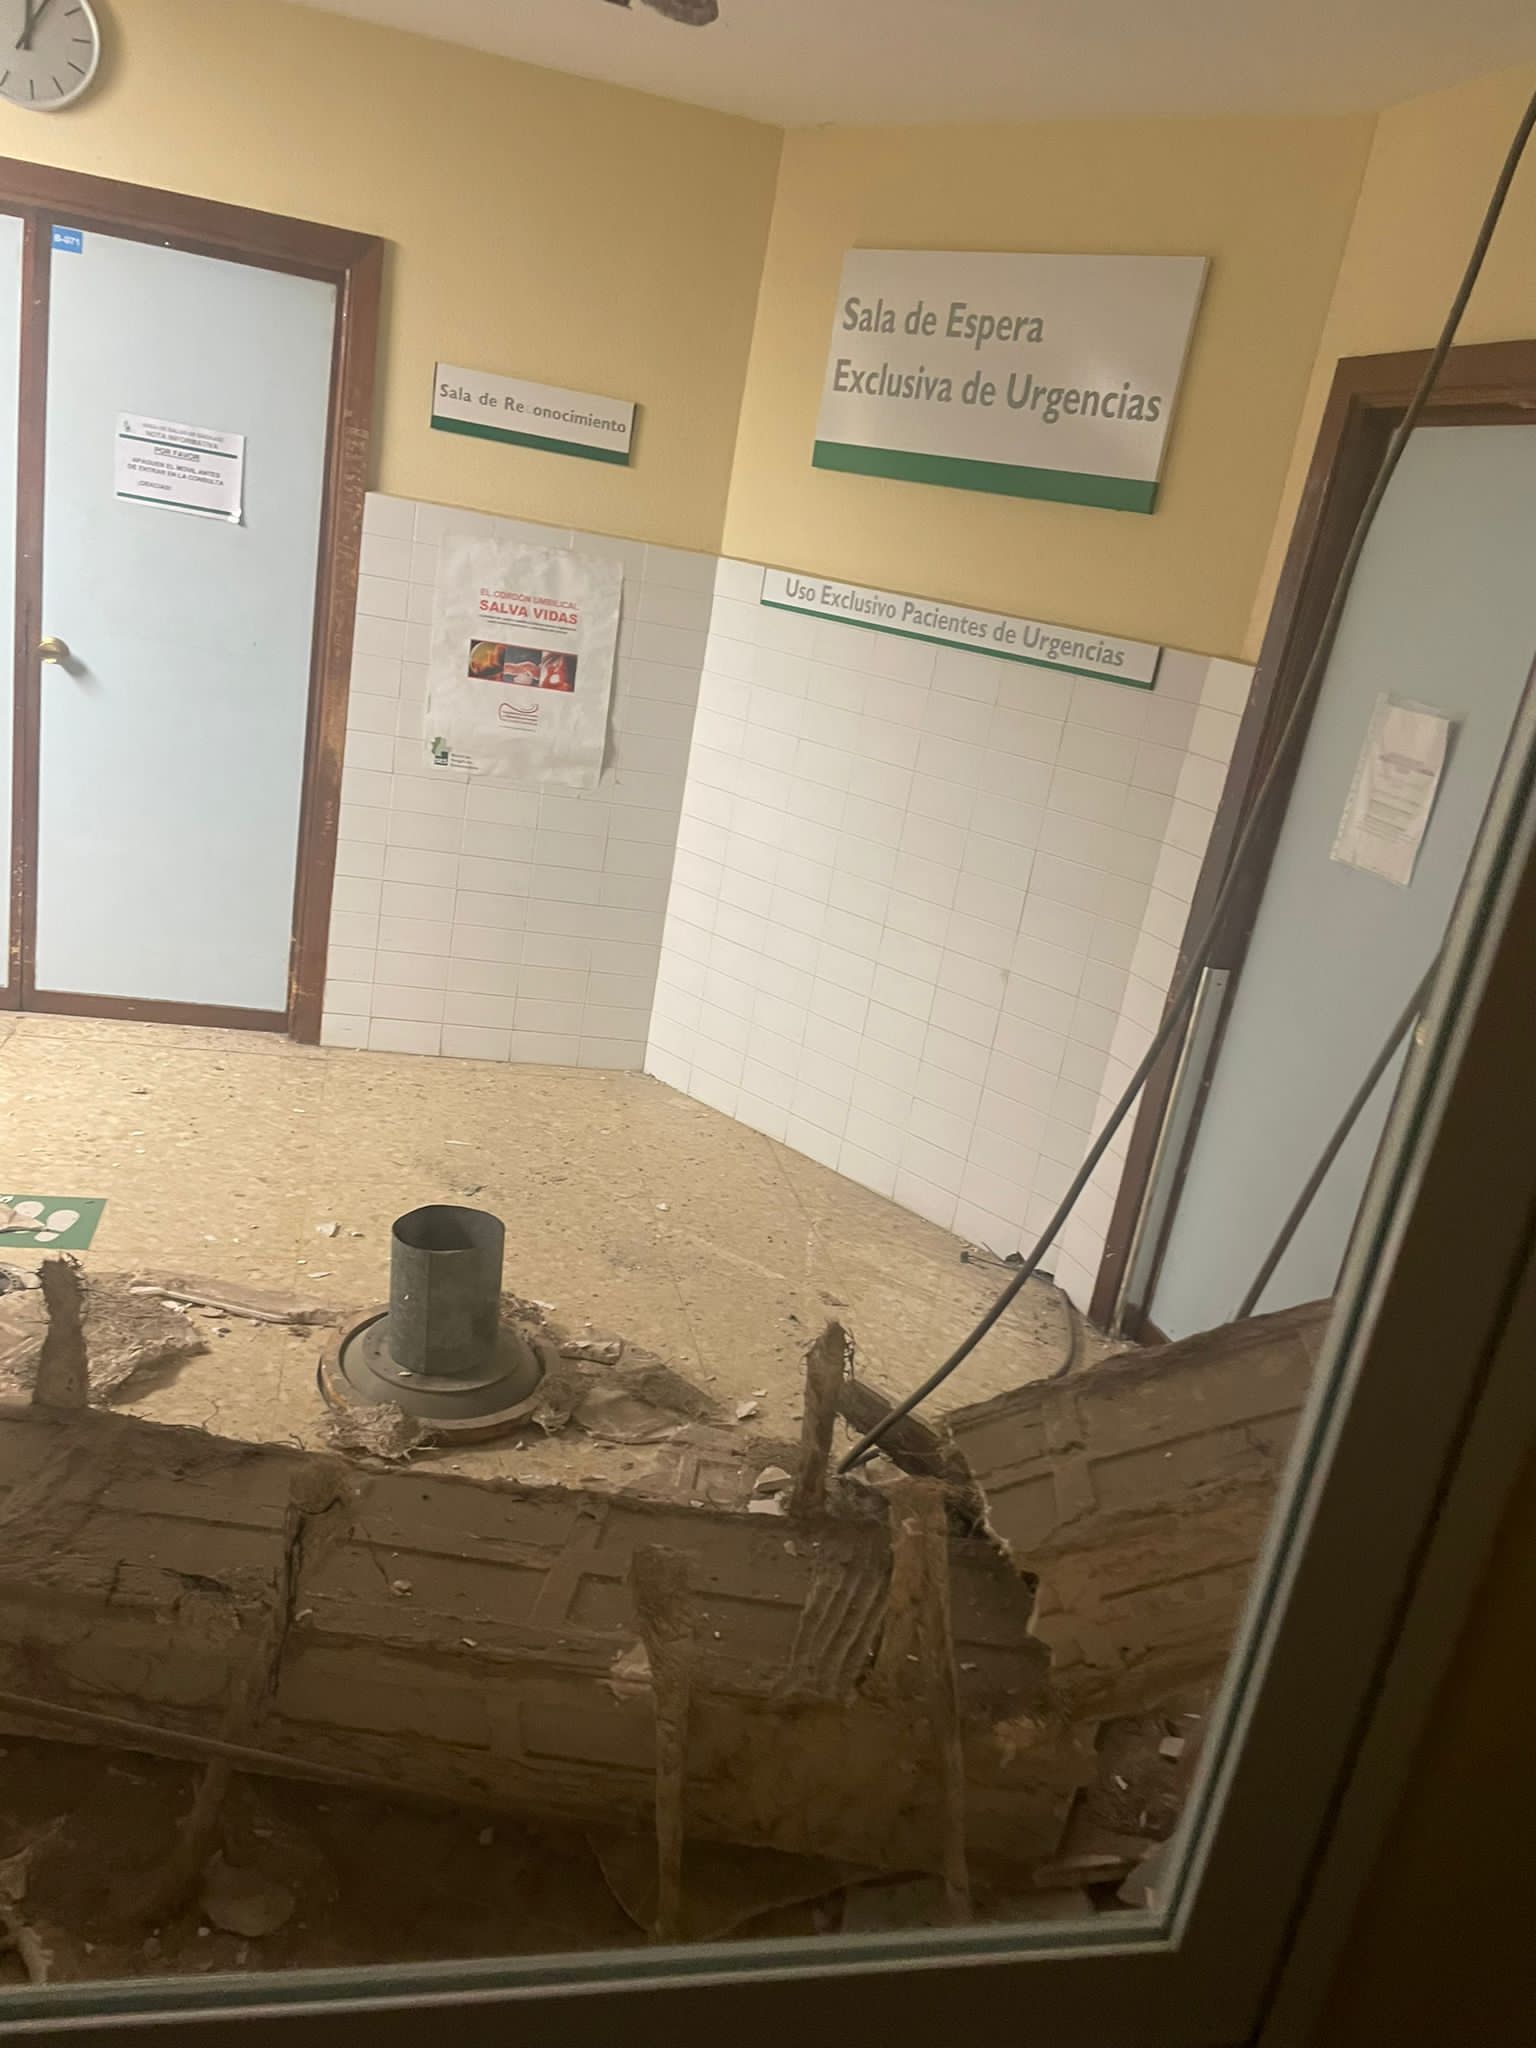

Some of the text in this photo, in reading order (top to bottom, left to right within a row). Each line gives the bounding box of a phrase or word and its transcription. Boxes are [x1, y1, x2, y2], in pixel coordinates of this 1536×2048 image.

[842, 297, 1044, 351] Sala de Espera
[440, 383, 626, 433] Sala de Reonocimiento
[832, 358, 1162, 424] Exclusiva de Urgencias
[154, 446, 200, 460] POR FAVOR
[479, 599, 528, 617] SALVA
[533, 607, 578, 625] VIDAS
[785, 577, 1125, 667] Uso Exclusivo Pacientes de Urgencias
